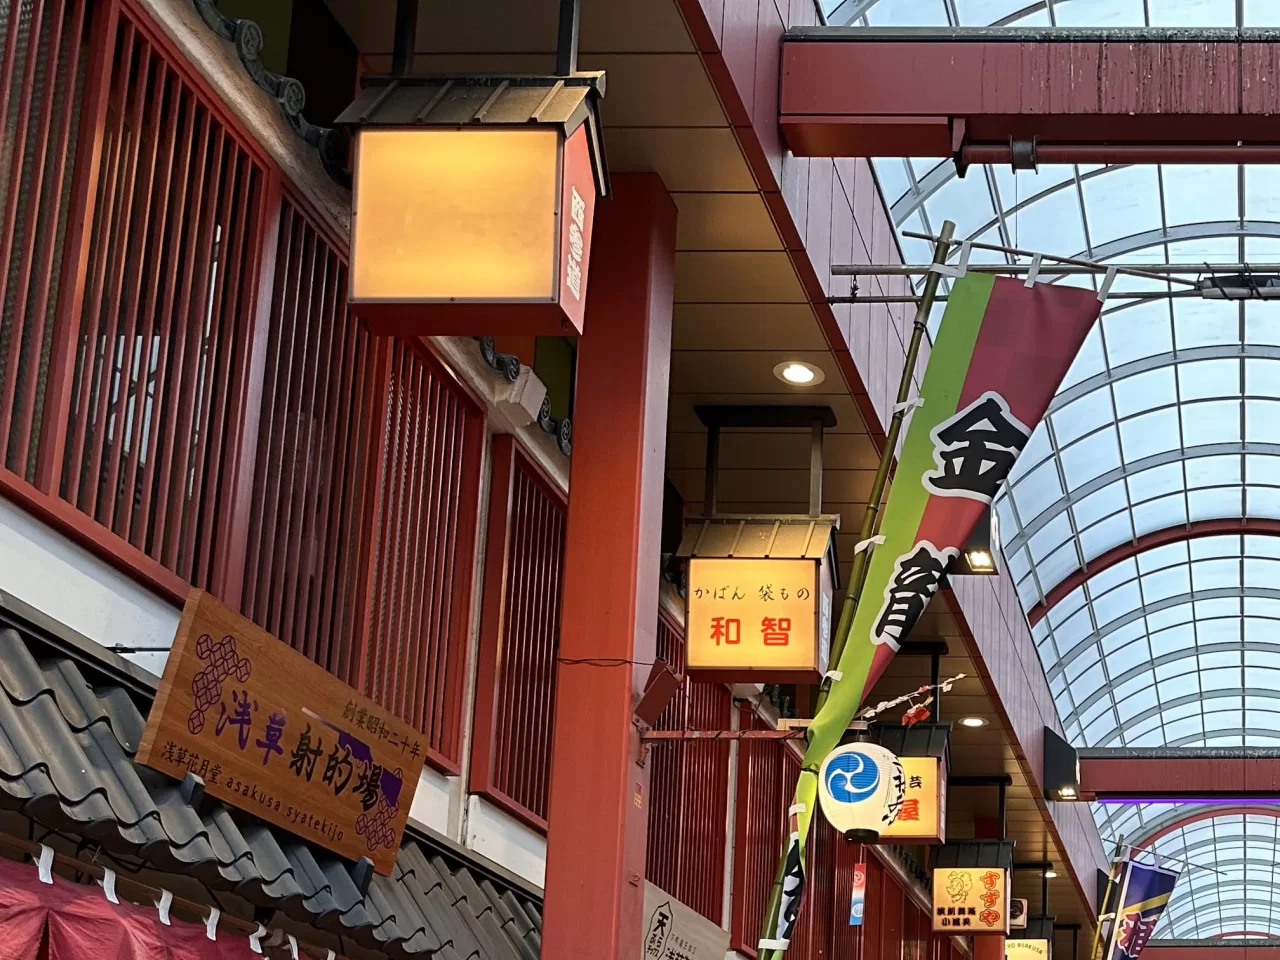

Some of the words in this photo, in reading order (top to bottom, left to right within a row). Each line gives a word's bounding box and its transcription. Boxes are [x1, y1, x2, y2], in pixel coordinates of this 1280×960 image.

[694, 584, 746, 600] かばん
[758, 583, 810, 602] 袋もの
[710, 616, 791, 646] 和智
[215, 690, 384, 812] 浅草射的場
[341, 700, 420, 760] 創業昭和二十年
[160, 741, 222, 785] 浅草花月堂
[226, 775, 281, 812] asakusa
[286, 807, 345, 843] syatekijo
